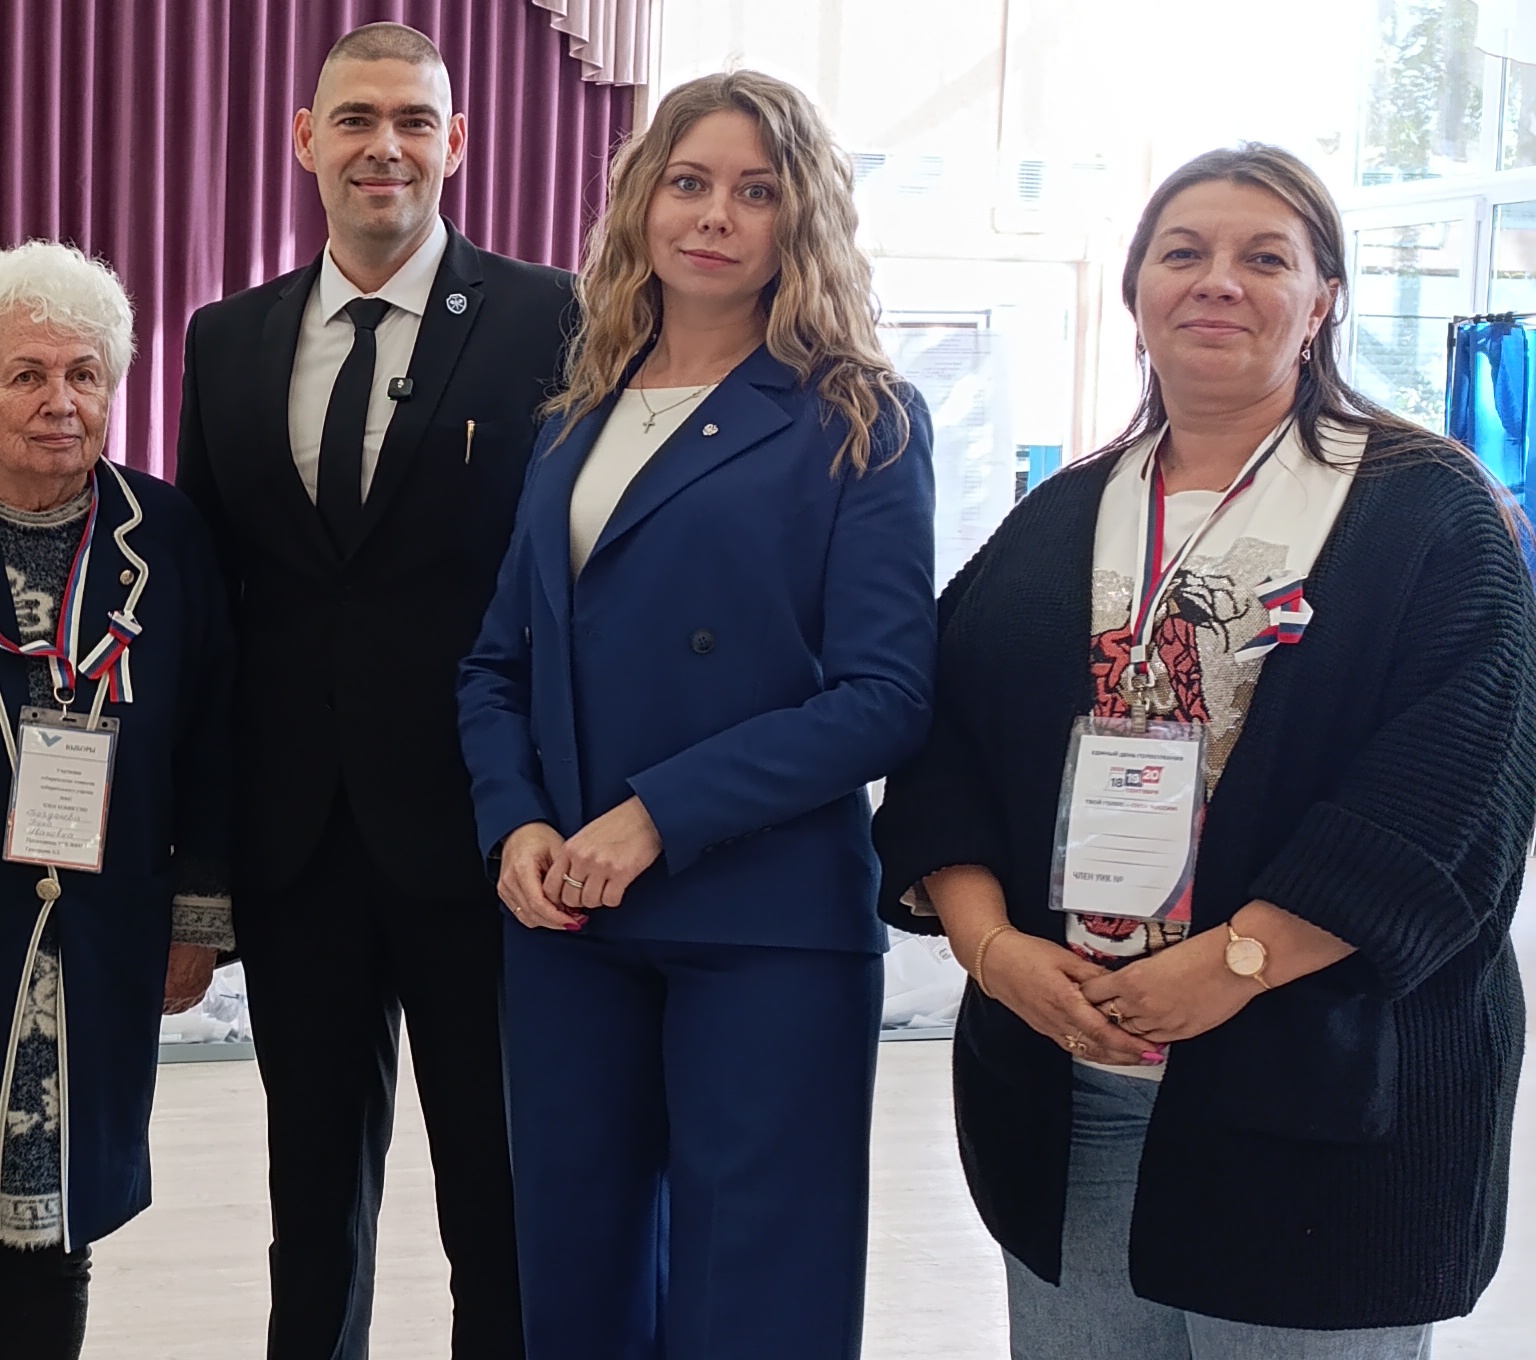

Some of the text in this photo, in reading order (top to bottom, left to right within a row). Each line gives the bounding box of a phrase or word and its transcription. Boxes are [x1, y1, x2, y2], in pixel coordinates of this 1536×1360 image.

[1111, 770, 1159, 787] 18 19 20
